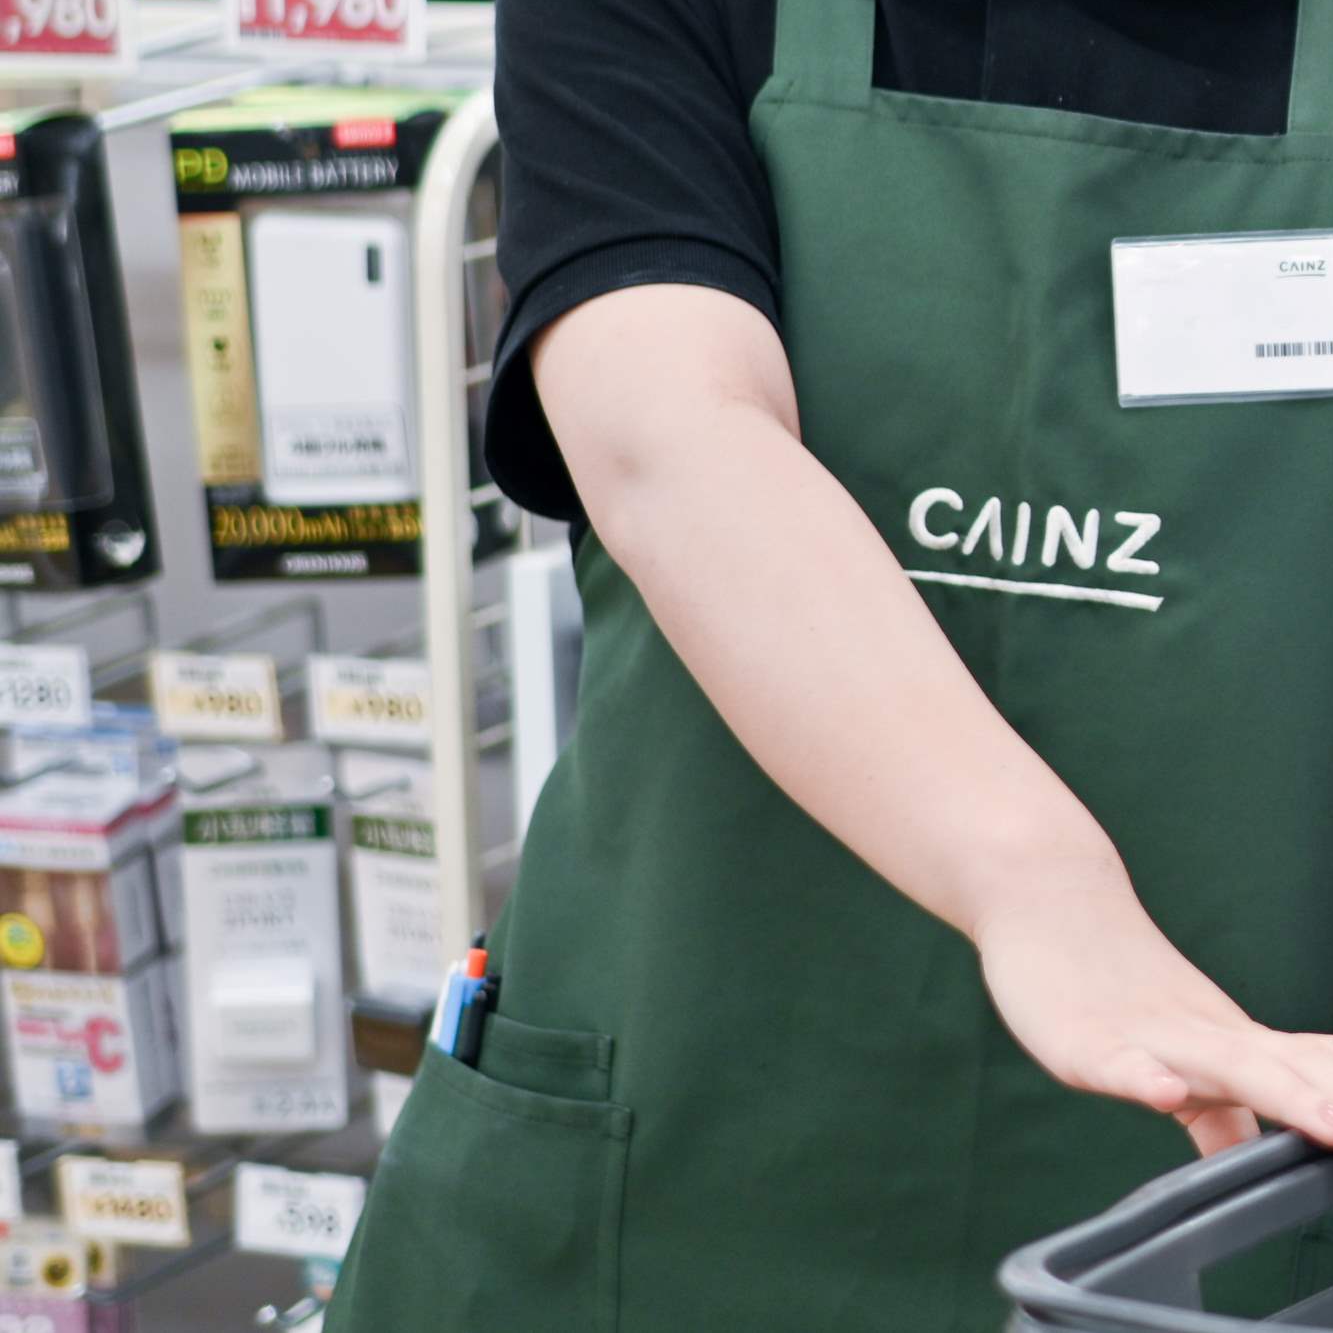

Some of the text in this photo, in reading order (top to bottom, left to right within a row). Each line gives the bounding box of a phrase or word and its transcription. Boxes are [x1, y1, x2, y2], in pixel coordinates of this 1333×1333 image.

[175, 147, 229, 185] PD
[232, 155, 399, 192] MOBILE BATTERY
[1279, 259, 1326, 273] CAINZ
[908, 487, 1162, 575] CAINZ
